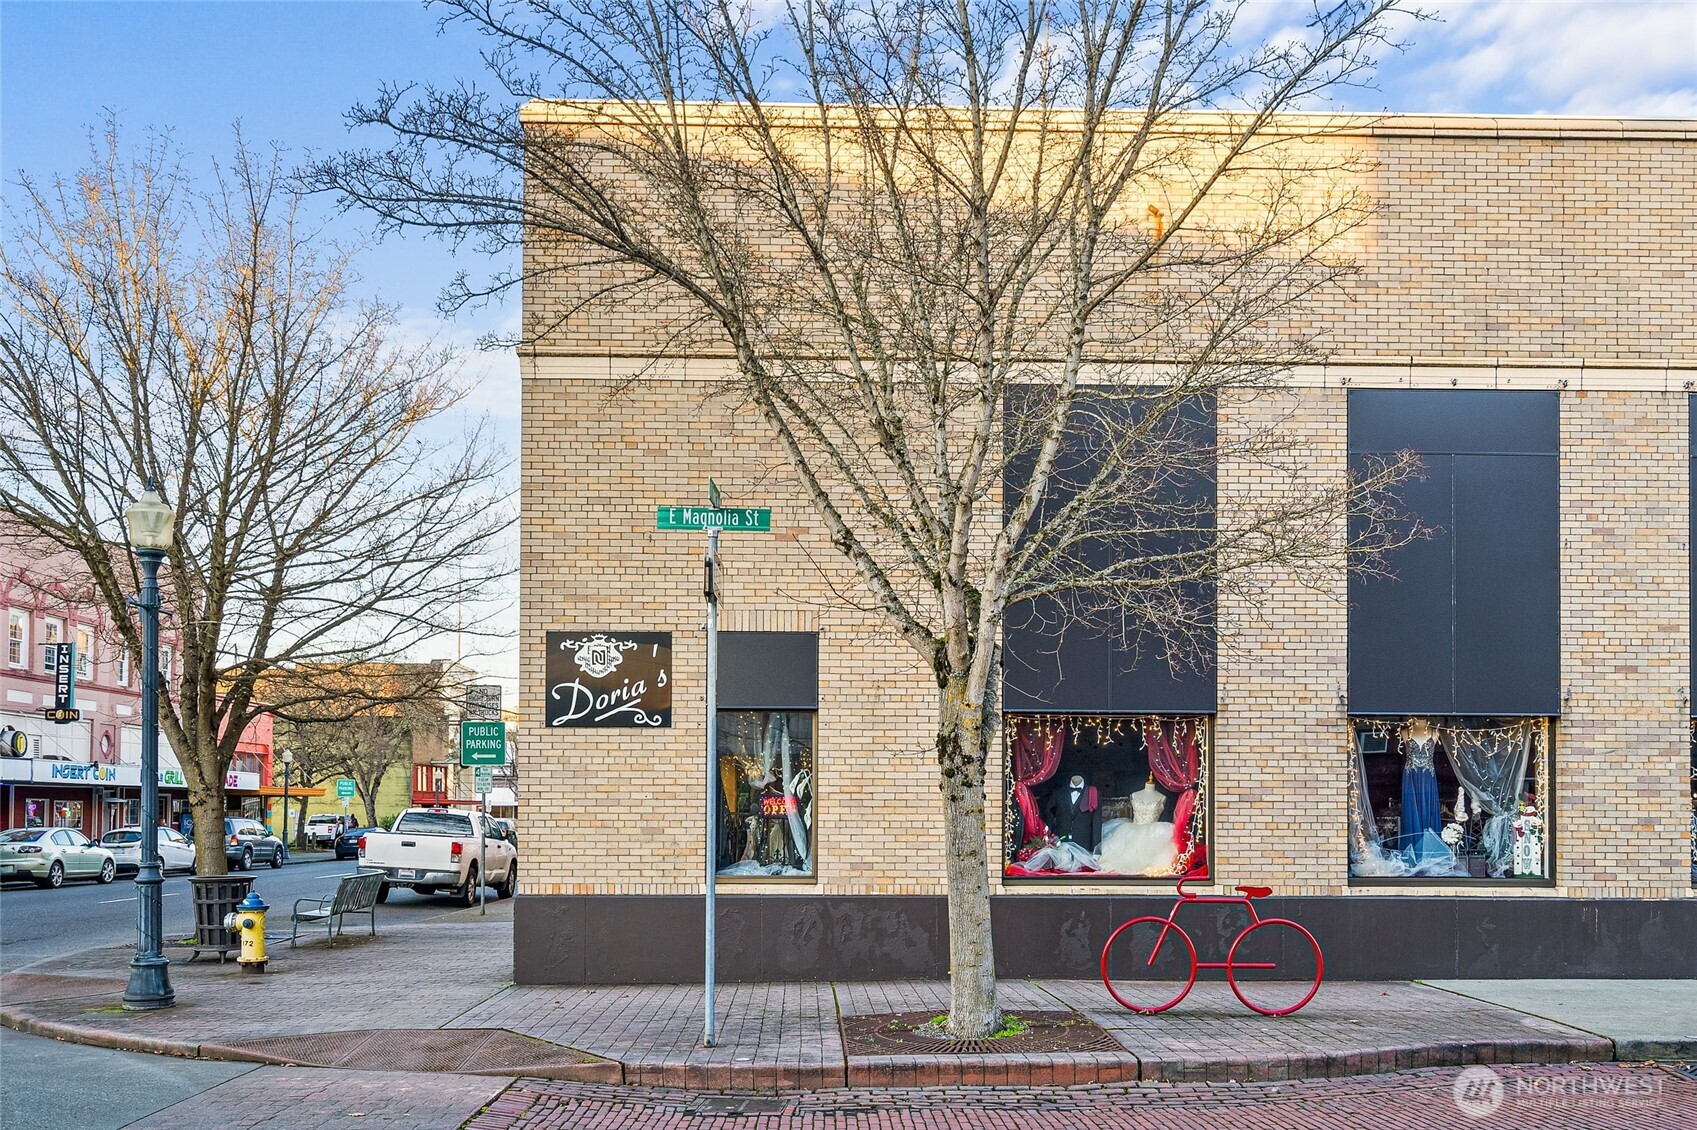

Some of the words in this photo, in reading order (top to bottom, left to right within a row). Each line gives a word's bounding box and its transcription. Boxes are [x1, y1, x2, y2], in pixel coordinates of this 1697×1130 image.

[669, 508, 677, 524] E
[683, 508, 739, 527] Magnolia
[745, 509, 759, 526] St
[58, 645, 69, 703] INSERT
[47, 709, 78, 719] COIN
[468, 726, 499, 737] PUBLIC
[466, 739, 502, 749] PARKING
[52, 763, 90, 780] INSERT
[93, 766, 116, 782] COIN
[164, 770, 184, 785] GRILL
[763, 804, 790, 815] OPE
